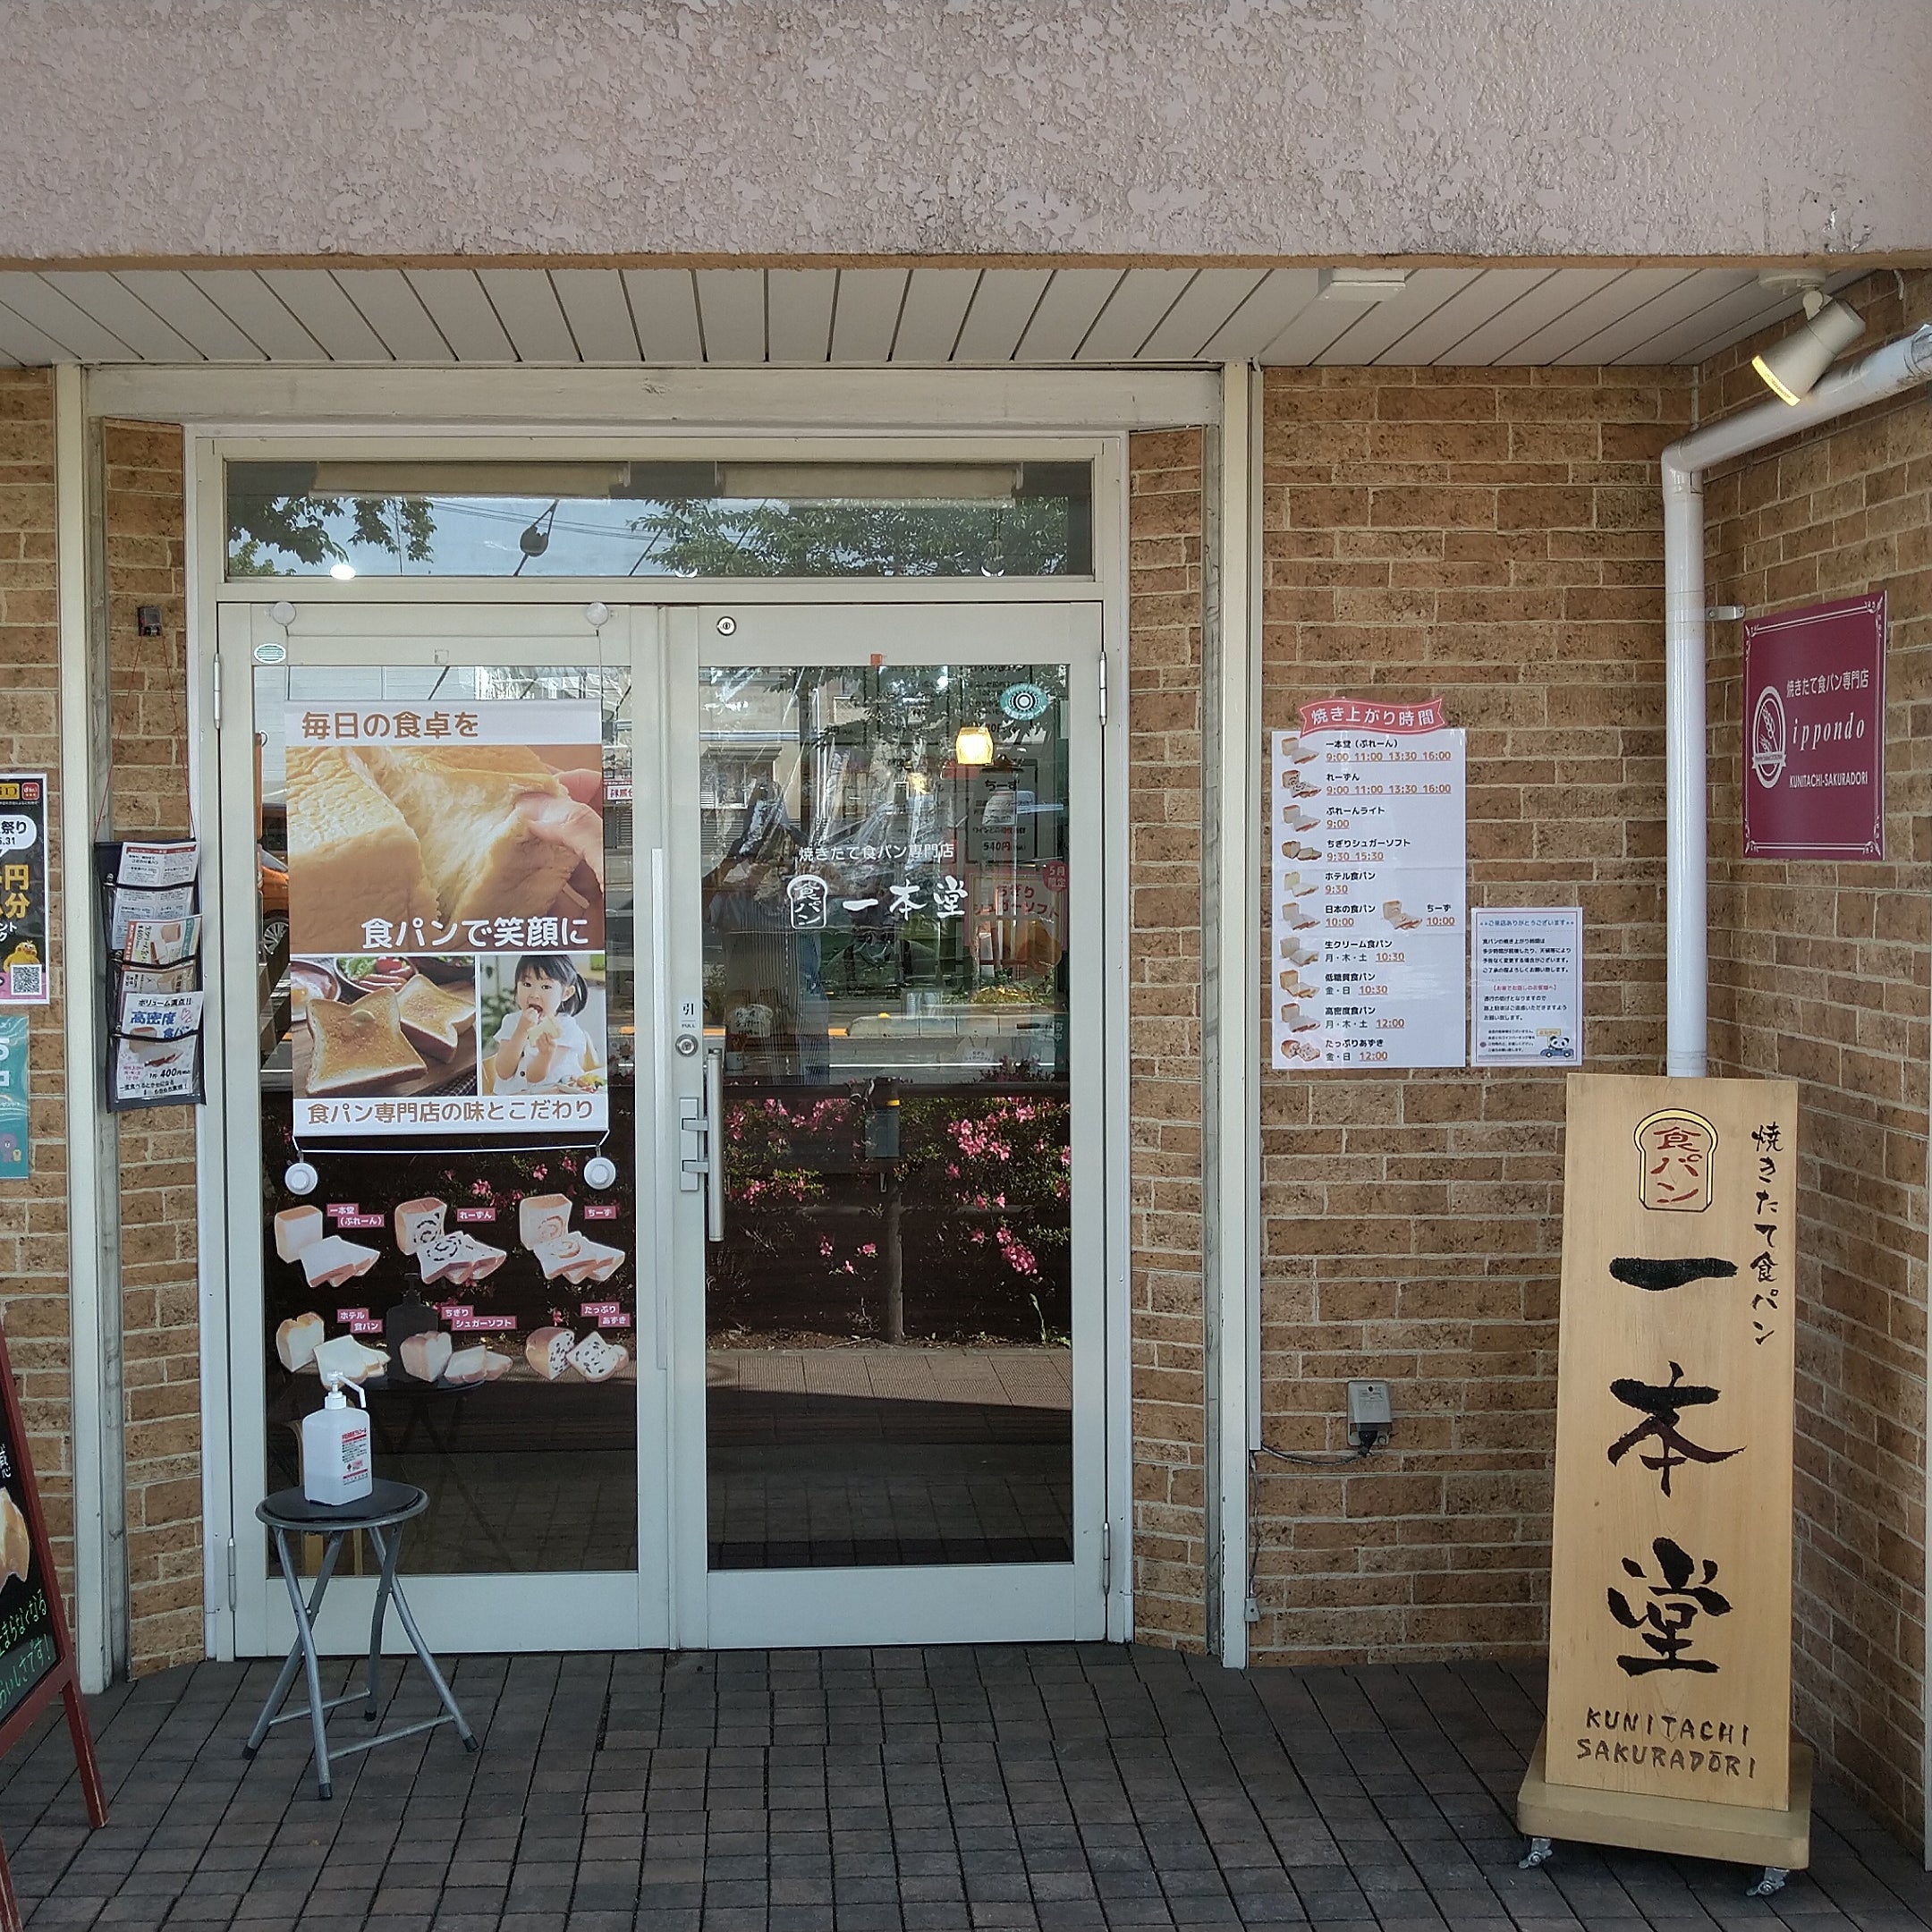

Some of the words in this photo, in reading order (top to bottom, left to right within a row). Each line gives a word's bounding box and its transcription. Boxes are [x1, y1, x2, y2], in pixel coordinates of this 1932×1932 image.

[1786, 668, 1869, 698] 焼きたて食パン専門店
[1311, 706, 1435, 726] 焼き上がり時間
[302, 711, 479, 740] 毎日の食卓を
[1792, 712, 1865, 751] ippondo
[1326, 752, 1349, 761] 9:00
[1355, 752, 1383, 761] 11:00
[1389, 751, 1417, 760] 13:30
[1423, 751, 1451, 760] 16:00
[1326, 773, 1360, 781] れーずん
[1789, 771, 1868, 788] KUNITACHI-SAKURADORI
[1326, 786, 1349, 794] 9:00
[1355, 786, 1383, 794] 11:00
[1389, 785, 1417, 793] 13:30
[1423, 785, 1451, 793] 16:00
[1326, 807, 1385, 816] ぷれーんライト
[1326, 819, 1349, 828] 9:00
[1327, 838, 1411, 848] ちぎりシュガーソフト
[799, 843, 954, 861] 焼きたて食パン専門店
[1326, 852, 1349, 861] 9:30
[1355, 852, 1384, 860] 15:30
[0, 864, 30, 891] 円
[1325, 872, 1376, 881] ホテル食パン
[1325, 885, 1348, 894] 9:30
[794, 879, 821, 926] 食パン
[843, 875, 969, 921] 一本堂
[0, 893, 30, 919] 分
[1325, 904, 1376, 913] 日本の食パン
[1427, 904, 1452, 912] ちーず
[1326, 918, 1354, 927] 10:00
[1427, 917, 1454, 926] 10:00
[361, 916, 589, 949] 食パンで笑顔に
[1325, 940, 1393, 949] 生クリーム食パン
[1376, 953, 1405, 962] 10:30
[1325, 973, 1376, 982] 低糖質食パン
[1359, 986, 1388, 995] 10:30
[682, 1003, 694, 1015] 引
[1325, 1007, 1376, 1016] 高密度食パン
[130, 1010, 176, 1025] 高密度
[1376, 1019, 1405, 1028] 12:00
[1326, 1039, 1384, 1047] たっぷりあずき
[1359, 1052, 1388, 1061] 12:00
[307, 1100, 594, 1124] 食パン専門店の味とこだわり
[1650, 1126, 1703, 1204] 食パン
[459, 1210, 493, 1219] れーずん
[588, 1209, 613, 1217] ちーず
[1750, 1121, 1784, 1345] 焼きたて食パン
[584, 1306, 616, 1314] たっぷり
[340, 1311, 365, 1319] ホテル
[456, 1319, 512, 1327] シュガーソフト
[602, 1317, 626, 1325] あずき
[354, 1323, 378, 1331] 食パン
[1607, 1257, 1748, 1677] 一本堂
[1586, 1706, 1749, 1746] KUNITACHI
